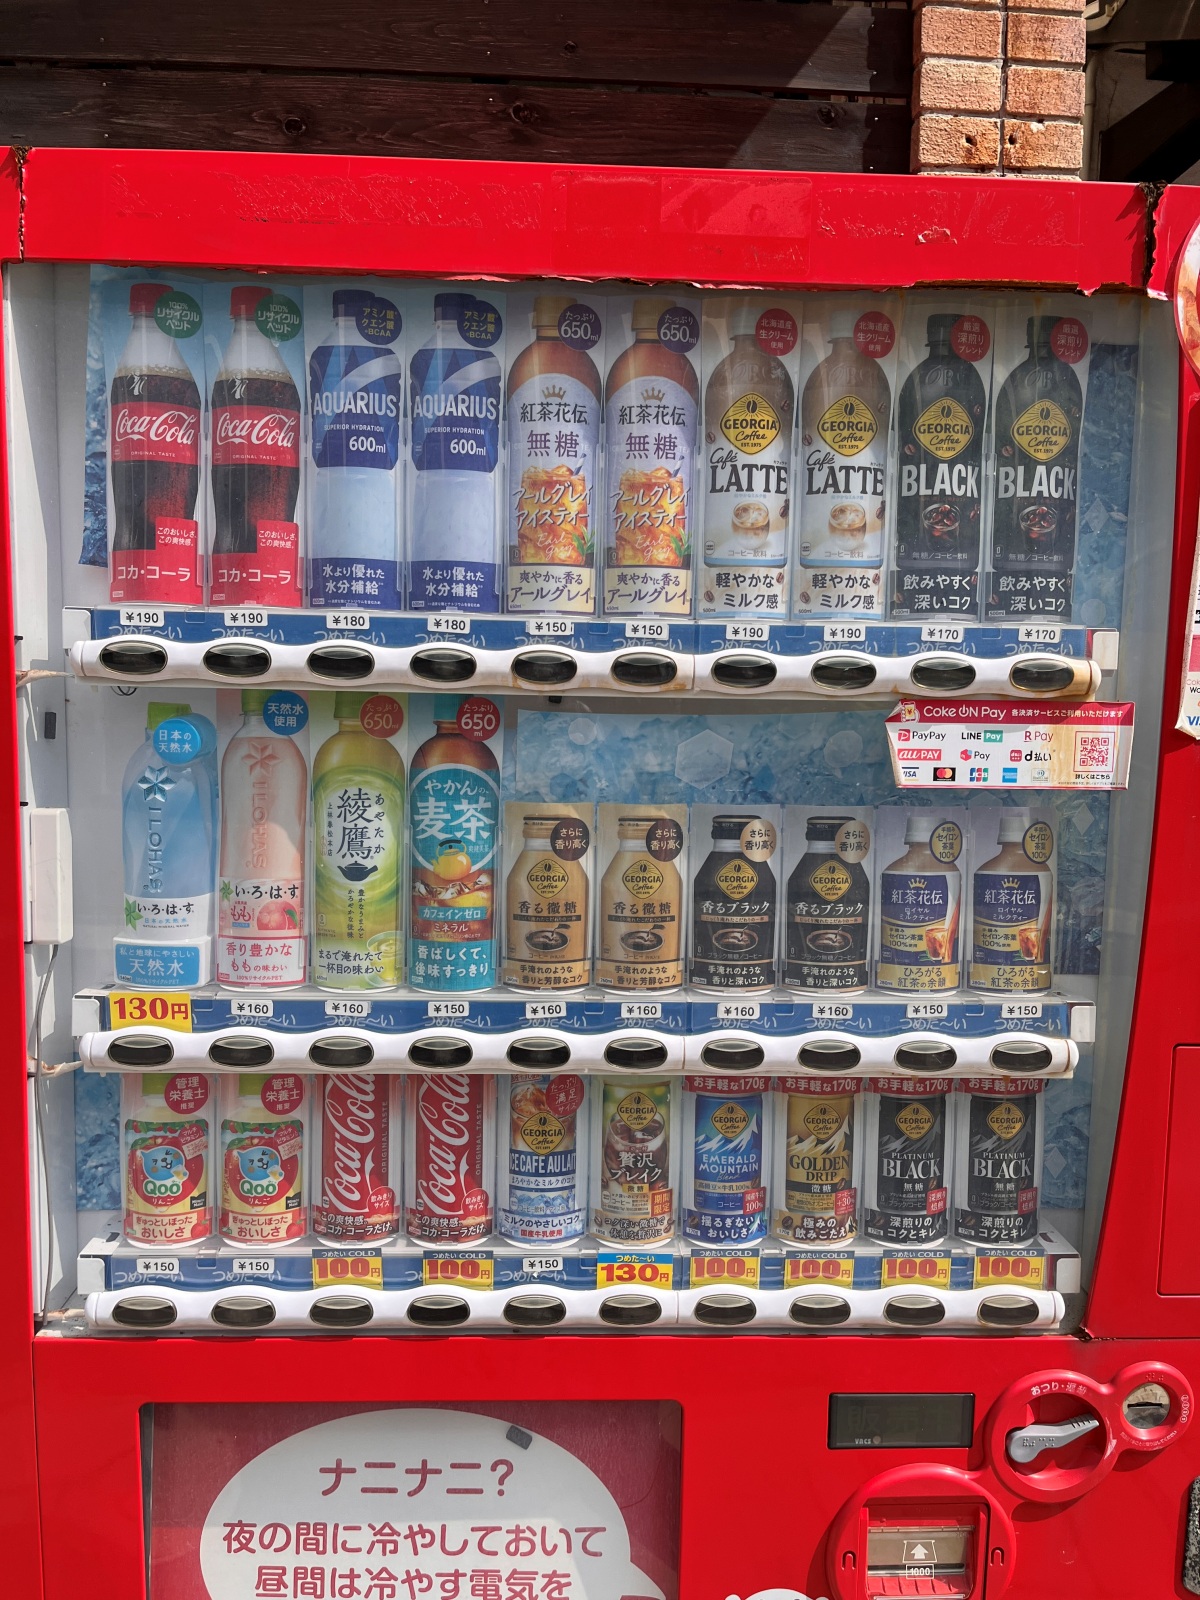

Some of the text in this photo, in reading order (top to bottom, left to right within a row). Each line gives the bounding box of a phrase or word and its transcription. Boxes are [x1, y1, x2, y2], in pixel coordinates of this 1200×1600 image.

[157, 308, 200, 322] リサイクル
[565, 311, 595, 323] たっぷり
[166, 319, 191, 331] ペット
[313, 391, 397, 418] AQUARIUS
[413, 395, 497, 421] AQUARIUS
[520, 402, 588, 425] 紅茶花伝
[618, 404, 687, 427] 紅茶花伝
[115, 408, 197, 445] Coca-Cola
[217, 412, 297, 448] Coca-Cola
[324, 424, 384, 432] SUPERIOR HYDRATION
[724, 417, 778, 432] GEORGIA
[820, 420, 875, 433] GEORGIA
[917, 423, 970, 437] GEORGIA
[1015, 425, 1068, 438] GEORGIA
[735, 430, 767, 442] Coffee
[349, 436, 386, 454] 600ml
[450, 439, 486, 456] 600ml
[527, 430, 580, 458] 無糖
[625, 432, 678, 460] 無糖
[709, 448, 738, 469] Café
[709, 463, 788, 494] LATTE
[805, 465, 884, 495] LATTE
[901, 463, 979, 499] BLACK
[998, 465, 1075, 500] BLACK
[512, 481, 593, 511] アールグレイ
[515, 508, 590, 532] アイスティー
[117, 565, 191, 582] コカ・コーラ
[322, 563, 385, 579] 水より優れた
[519, 570, 583, 586] 爽やかに香る
[715, 572, 775, 589] 軽やかな
[812, 573, 870, 590] 軽やかな
[904, 574, 970, 590] 飲みやすく
[999, 576, 1066, 592] 飲みやすく
[724, 594, 778, 609] ミルク感
[820, 594, 875, 610] ミルク感
[914, 594, 971, 610] 深いコク
[1010, 595, 1066, 612] 深いコク
[125, 612, 159, 624] ¥190
[230, 612, 263, 624] ¥190
[332, 615, 365, 627] ¥180
[433, 618, 466, 631] ¥180
[535, 621, 567, 633] ¥150
[631, 625, 663, 636] ¥150
[927, 628, 959, 640] ¥170
[1024, 629, 1056, 641] ¥170
[267, 702, 304, 715] 天然水
[923, 705, 956, 718] Coke
[981, 706, 1006, 720] Pay
[274, 715, 297, 728] 使用
[461, 714, 496, 731] 650
[158, 729, 192, 741] 日本の
[912, 731, 946, 742] PayPay
[961, 732, 1001, 742] LINE Pay
[1034, 731, 1054, 743] Pay
[159, 742, 193, 753] 天然水
[920, 750, 939, 760] PAY
[973, 751, 990, 761] Pay
[1024, 751, 1052, 762] d払い
[336, 787, 373, 860] 綾鷹
[413, 796, 496, 842] 麦茶
[560, 828, 583, 838] さらに
[936, 833, 959, 842] セイロン
[555, 839, 586, 850] 香り高く
[891, 889, 943, 905] 紅茶花伝
[984, 889, 1036, 904] 紅茶花伝
[518, 901, 578, 914] 香る微糖
[702, 901, 770, 915] 香るブラック
[795, 902, 863, 916] 香るブラック
[423, 909, 481, 921] カフェインゼロ
[226, 942, 292, 958] 香り豊かな
[319, 949, 383, 962] まるで淹れたて
[417, 945, 487, 961] 香ばしくて、
[129, 958, 184, 976] 天然水
[319, 962, 384, 975] 一杯目の味わい
[415, 962, 488, 977] 後味すっきり
[904, 967, 943, 977] ひろがる
[898, 977, 946, 988] 紅茶の余韻
[113, 997, 189, 1020] 130円
[237, 1003, 269, 1014] ¥160
[332, 1002, 364, 1014] ¥160
[176, 1076, 199, 1088] 管理
[169, 1089, 204, 1101] 栄養士
[619, 1152, 655, 1168] 贅沢
[703, 1154, 757, 1163] EMERALD
[789, 1154, 850, 1172] GOLDEN
[611, 1167, 661, 1181] ブレイク
[699, 1162, 758, 1174] MOUNTAIN
[882, 1158, 941, 1180] BLACK
[972, 1158, 1032, 1179] BLACK
[806, 1171, 837, 1181] DRIP
[143, 1179, 181, 1196] Qoo
[374, 1200, 390, 1209] サイズ
[653, 1203, 670, 1214] 限定
[135, 1216, 193, 1227] ぎゅっとしぼった
[701, 1215, 754, 1228] 揺るぎない
[803, 1217, 837, 1228] 極みの
[889, 1216, 933, 1228] 深煎りの
[141, 1226, 185, 1238] おいしさ
[520, 1229, 563, 1237] 国産牛乳使用
[795, 1227, 847, 1239] 飲みごたえ
[887, 1228, 936, 1239] コクとキレ
[316, 1258, 380, 1279] 100円
[426, 1260, 490, 1280] 100円
[600, 1263, 669, 1282] 130円
[694, 1258, 756, 1278] 100円
[319, 1458, 514, 1497] ナニナニ?
[222, 1521, 608, 1558] 夜の間に冷やしておいて
[910, 1567, 930, 1576] 1000
[254, 1565, 573, 1600] 昼間は冷やす電気を
